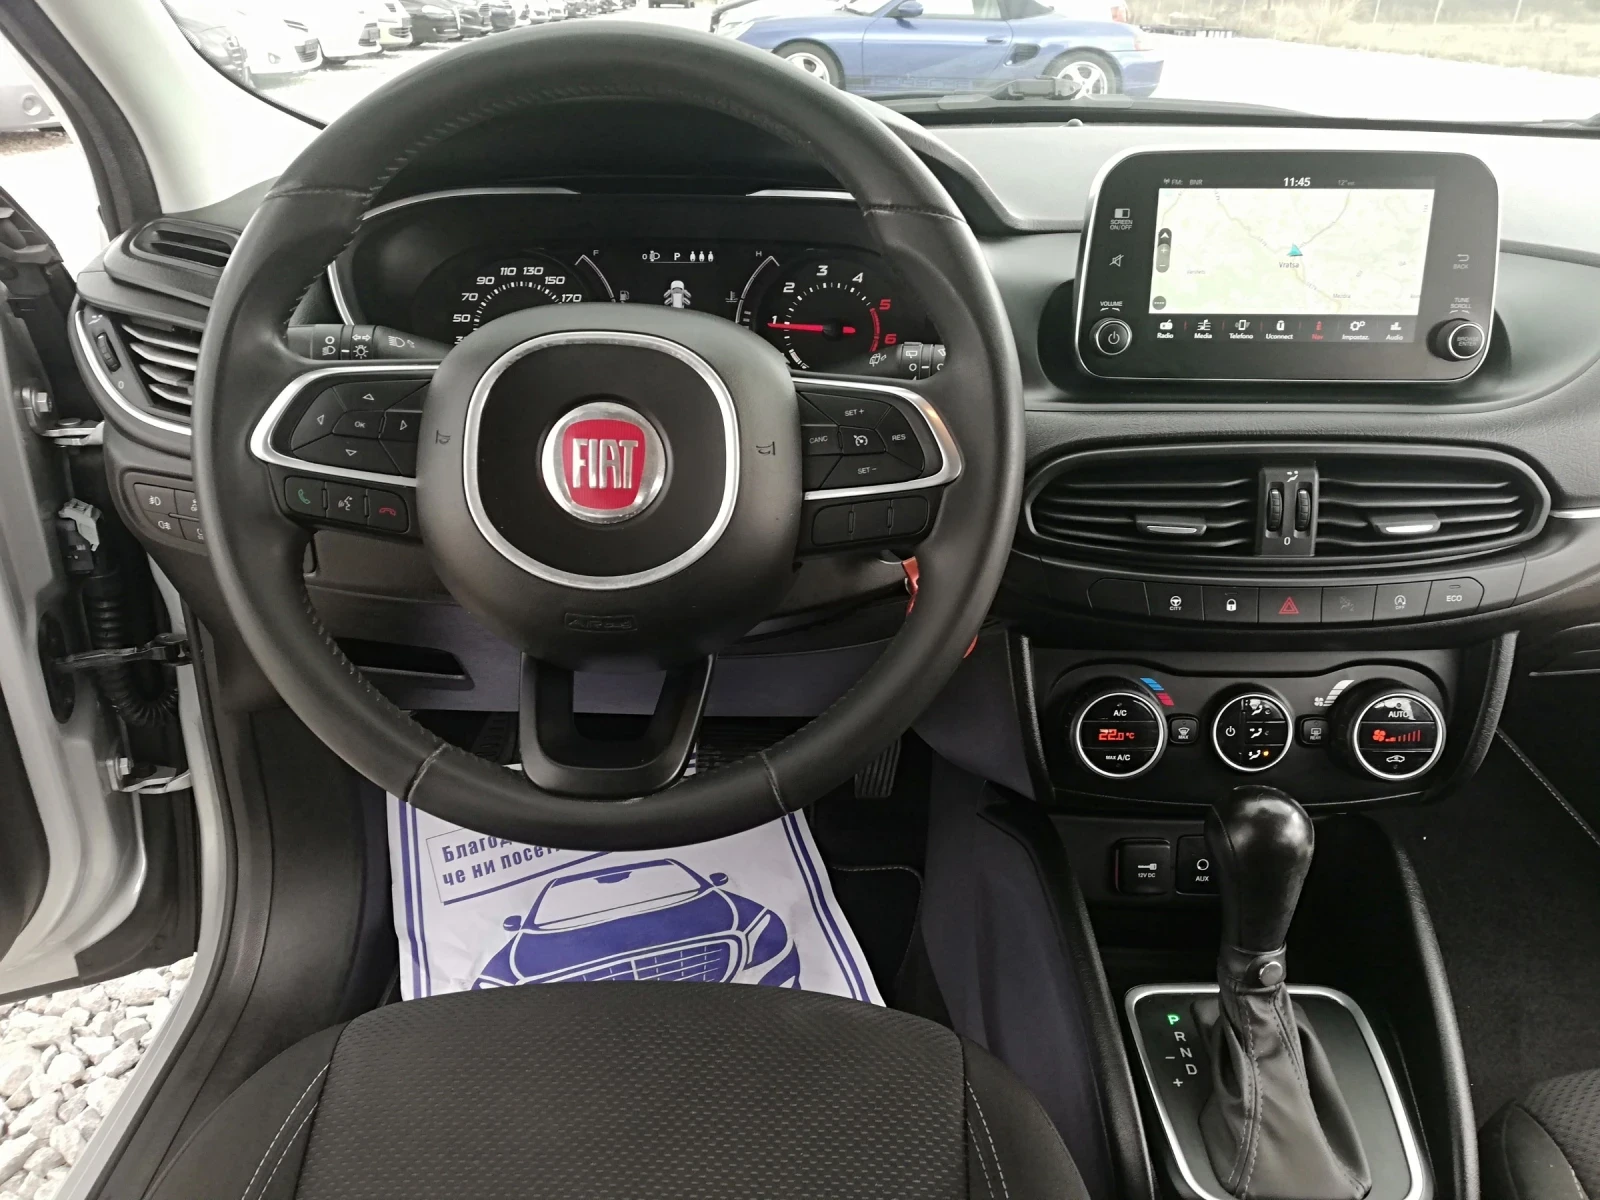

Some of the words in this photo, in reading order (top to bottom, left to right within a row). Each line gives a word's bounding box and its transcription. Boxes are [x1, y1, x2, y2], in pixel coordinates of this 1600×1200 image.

[1283, 176, 1311, 188] 11:45
[673, 252, 681, 260] P
[1278, 261, 1300, 269] Vratsa
[500, 267, 517, 276] 110
[523, 266, 544, 276] 130
[816, 264, 829, 277] 3
[476, 276, 495, 285] 90
[545, 276, 566, 285] 150
[851, 273, 864, 283] 4
[782, 282, 796, 293] 2
[461, 292, 479, 301] 70
[561, 294, 582, 303] 170
[879, 298, 891, 310] 5
[452, 314, 471, 323] 50
[771, 315, 778, 324] 1
[884, 333, 897, 345] 6
[1229, 332, 1254, 340] Telefono
[354, 420, 366, 429] OK
[809, 435, 828, 444] CANC
[891, 433, 906, 441] RES
[572, 437, 639, 489] FIAT
[857, 466, 870, 475] SET
[1113, 709, 1128, 717] A/C
[1098, 728, 1125, 741] 22.0
[442, 869, 466, 886] че
[471, 859, 496, 879] ни
[1167, 1014, 1180, 1025] P
[1173, 1031, 1187, 1042] R
[1179, 1047, 1193, 1058] N
[1185, 1063, 1198, 1075] D
